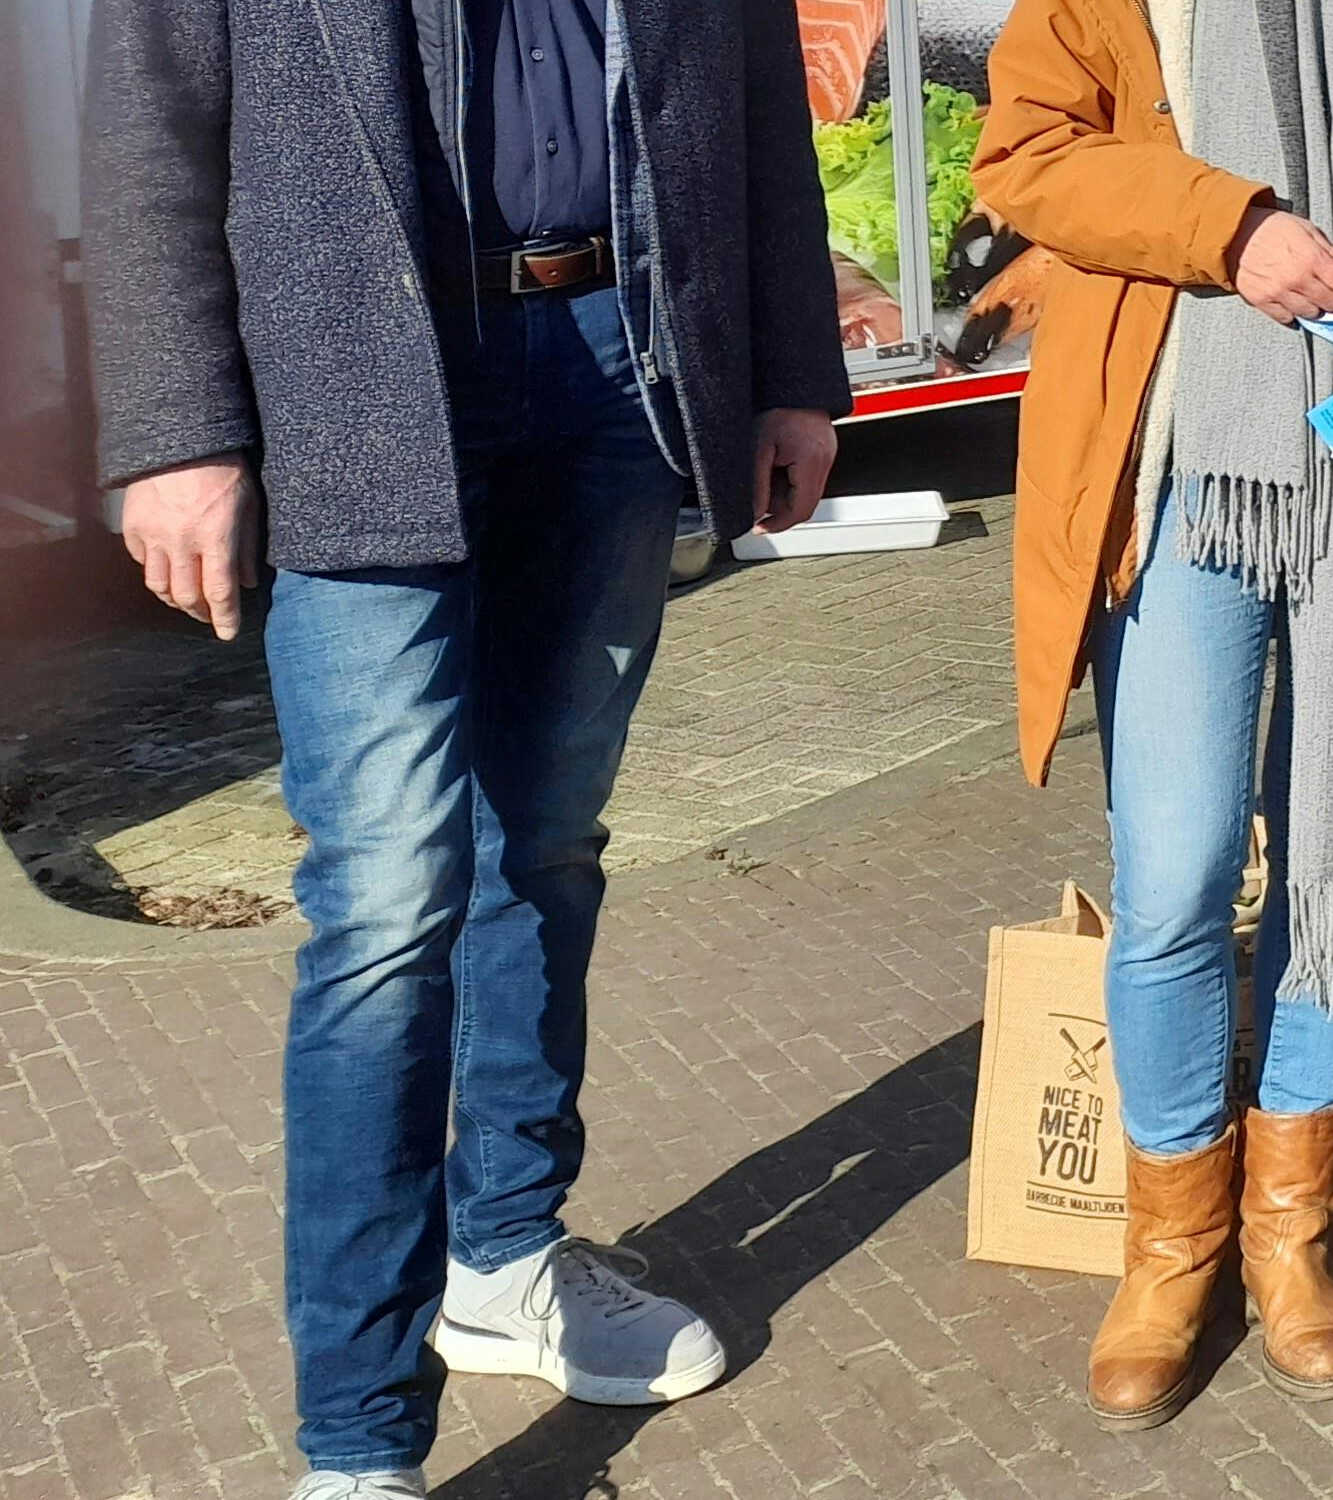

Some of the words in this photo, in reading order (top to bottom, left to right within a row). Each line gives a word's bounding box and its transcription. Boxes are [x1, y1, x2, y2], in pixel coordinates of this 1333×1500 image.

[1043, 1085, 1082, 1110] NICE
[1088, 1094, 1103, 1116] TO
[1038, 1107, 1102, 1145] MEAT
[1038, 1137, 1098, 1185] YOU
[1026, 1188, 1067, 1208] BARBECUE
[1070, 1198, 1125, 1213] MAALTIJDEN
